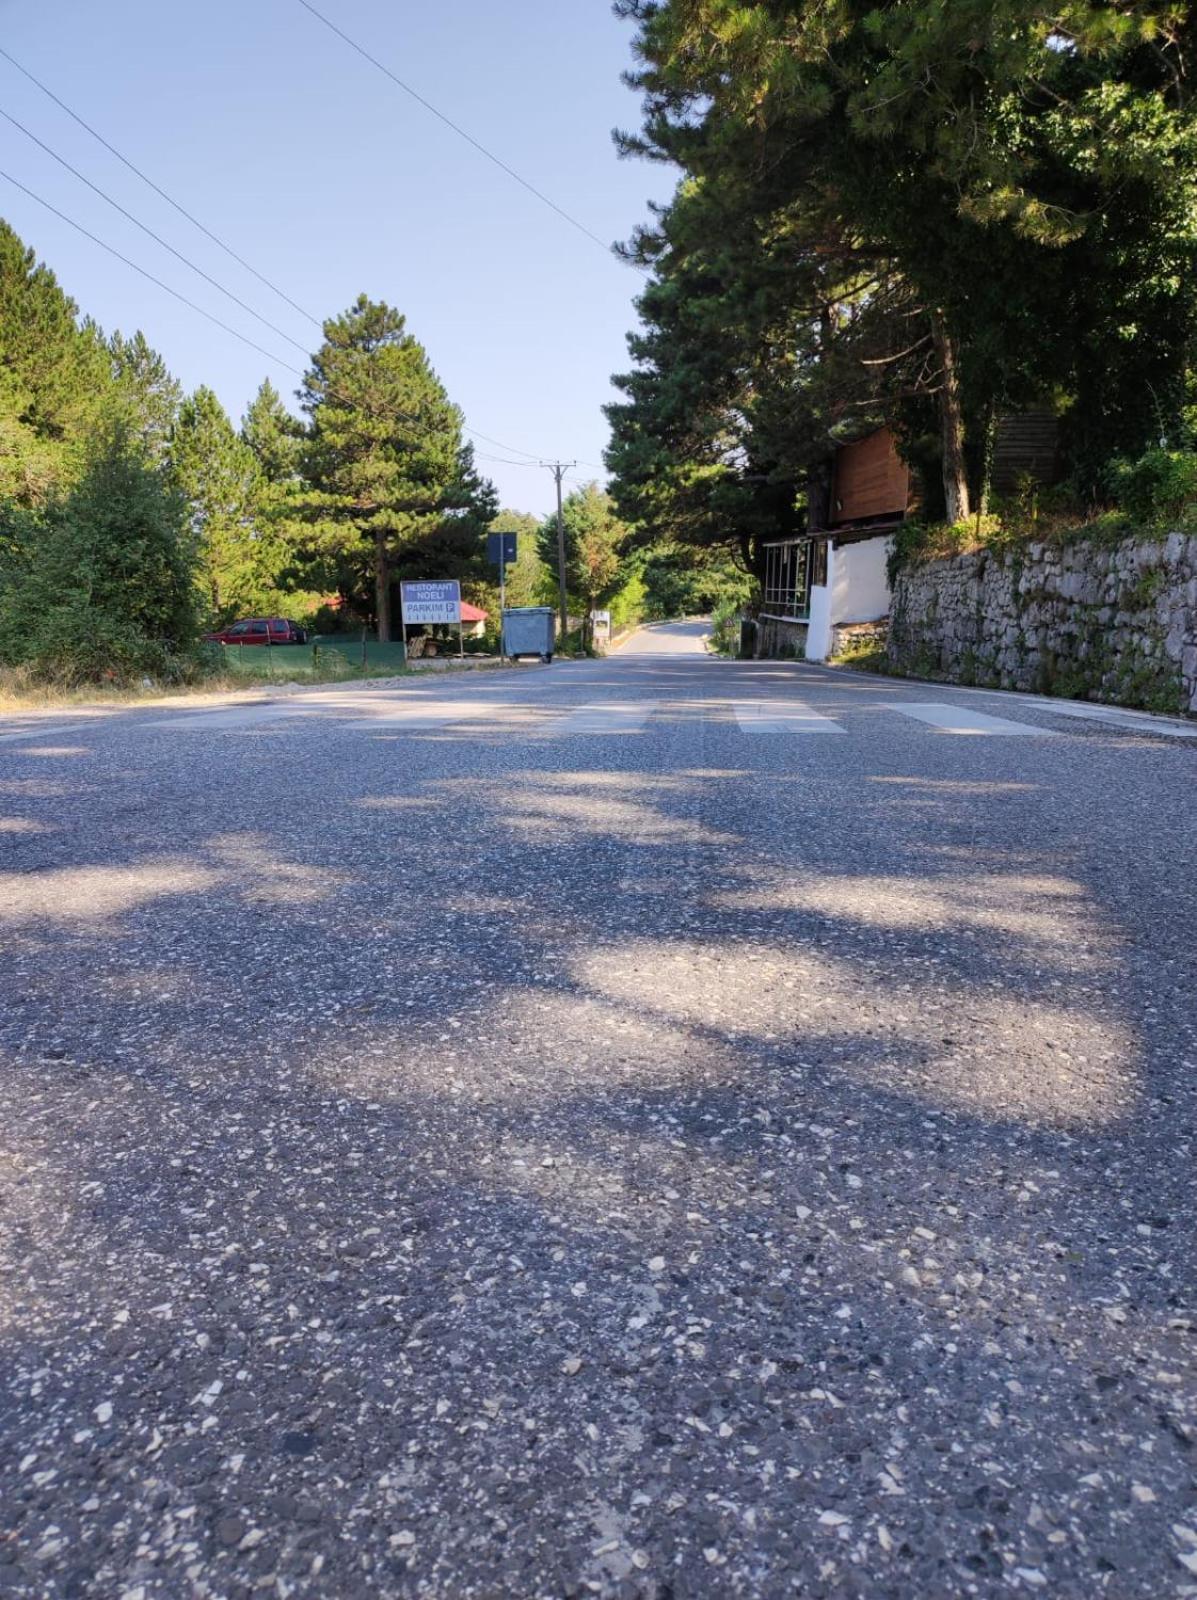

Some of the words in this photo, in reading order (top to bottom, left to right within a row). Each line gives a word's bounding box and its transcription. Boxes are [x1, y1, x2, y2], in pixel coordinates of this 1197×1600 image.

[406, 583, 453, 592] RESTORANT
[407, 603, 443, 612] PARKIM
[447, 603, 455, 612] P
